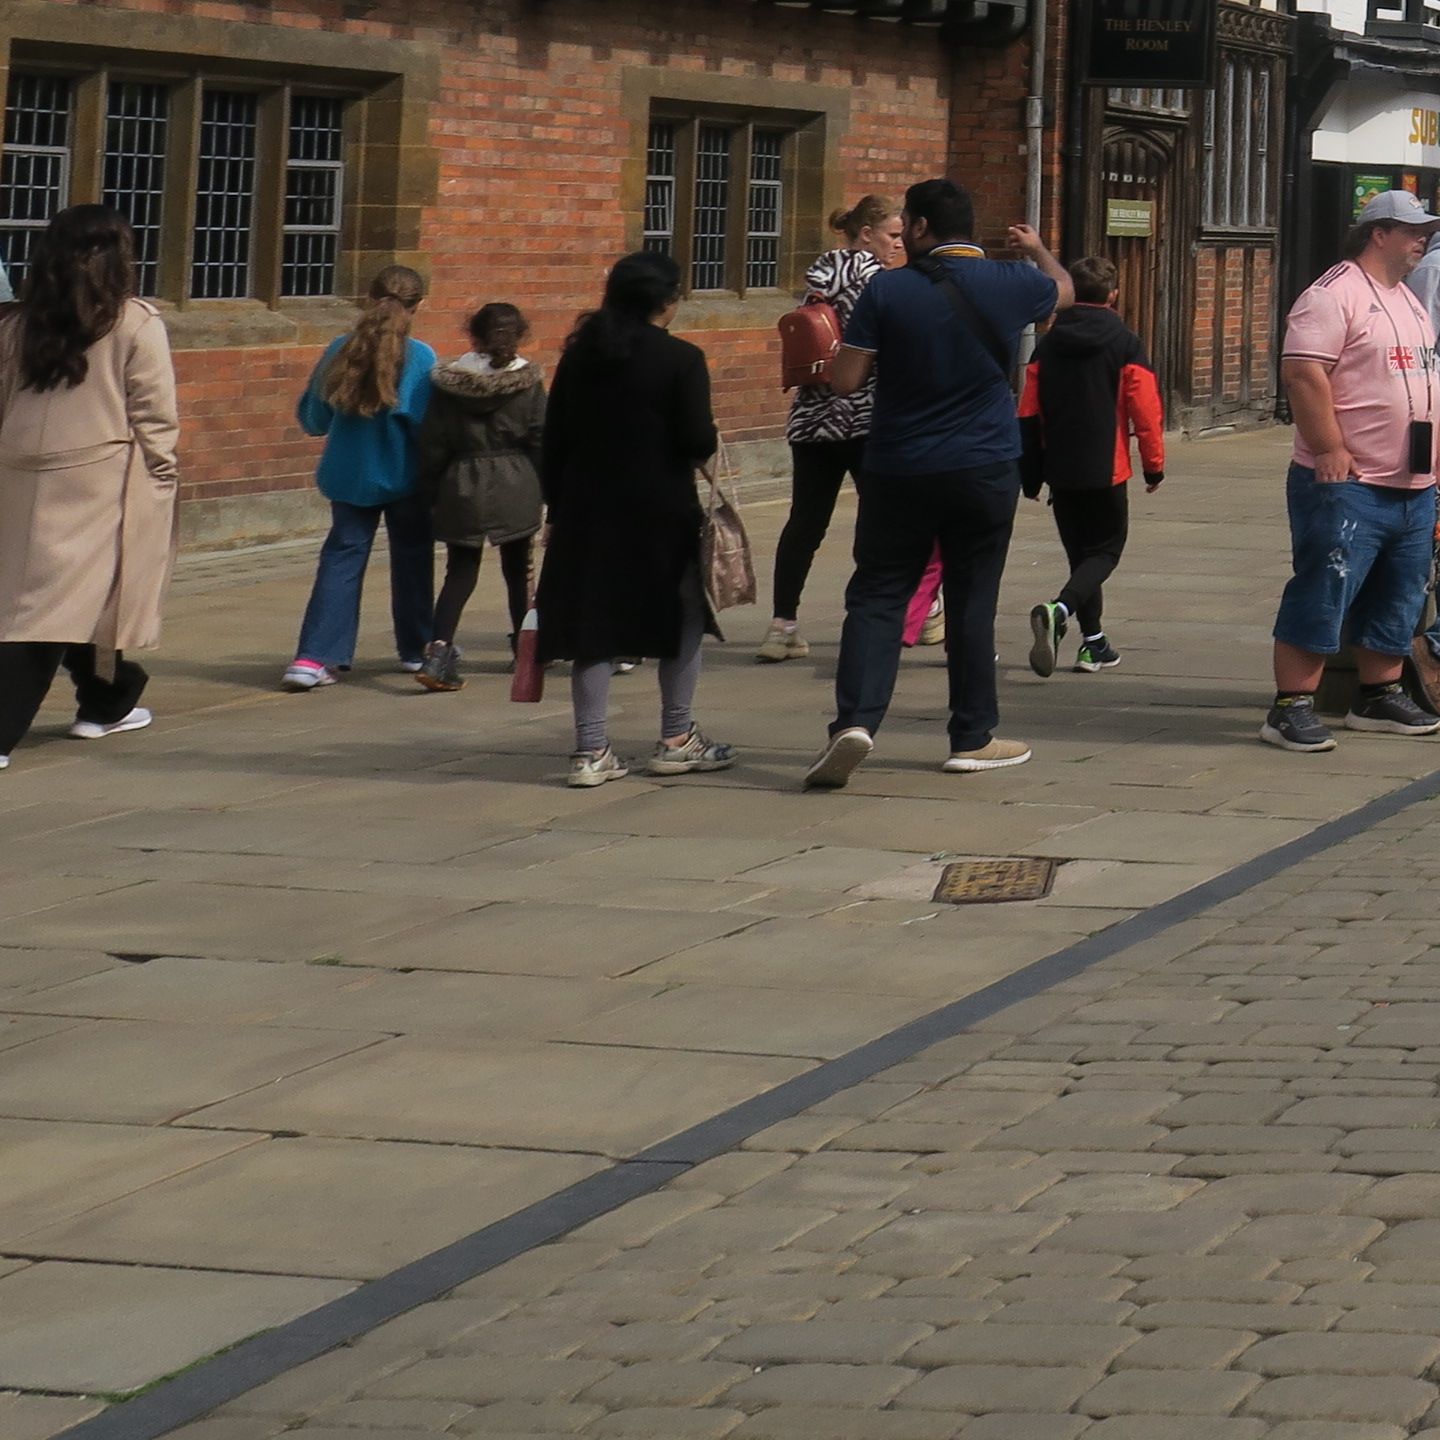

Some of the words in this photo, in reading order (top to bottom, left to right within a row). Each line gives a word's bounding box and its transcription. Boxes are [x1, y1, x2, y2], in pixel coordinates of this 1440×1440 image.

[1104, 18, 1131, 31] THE
[1136, 19, 1192, 32] HENLEY
[1126, 38, 1169, 51] ROOM
